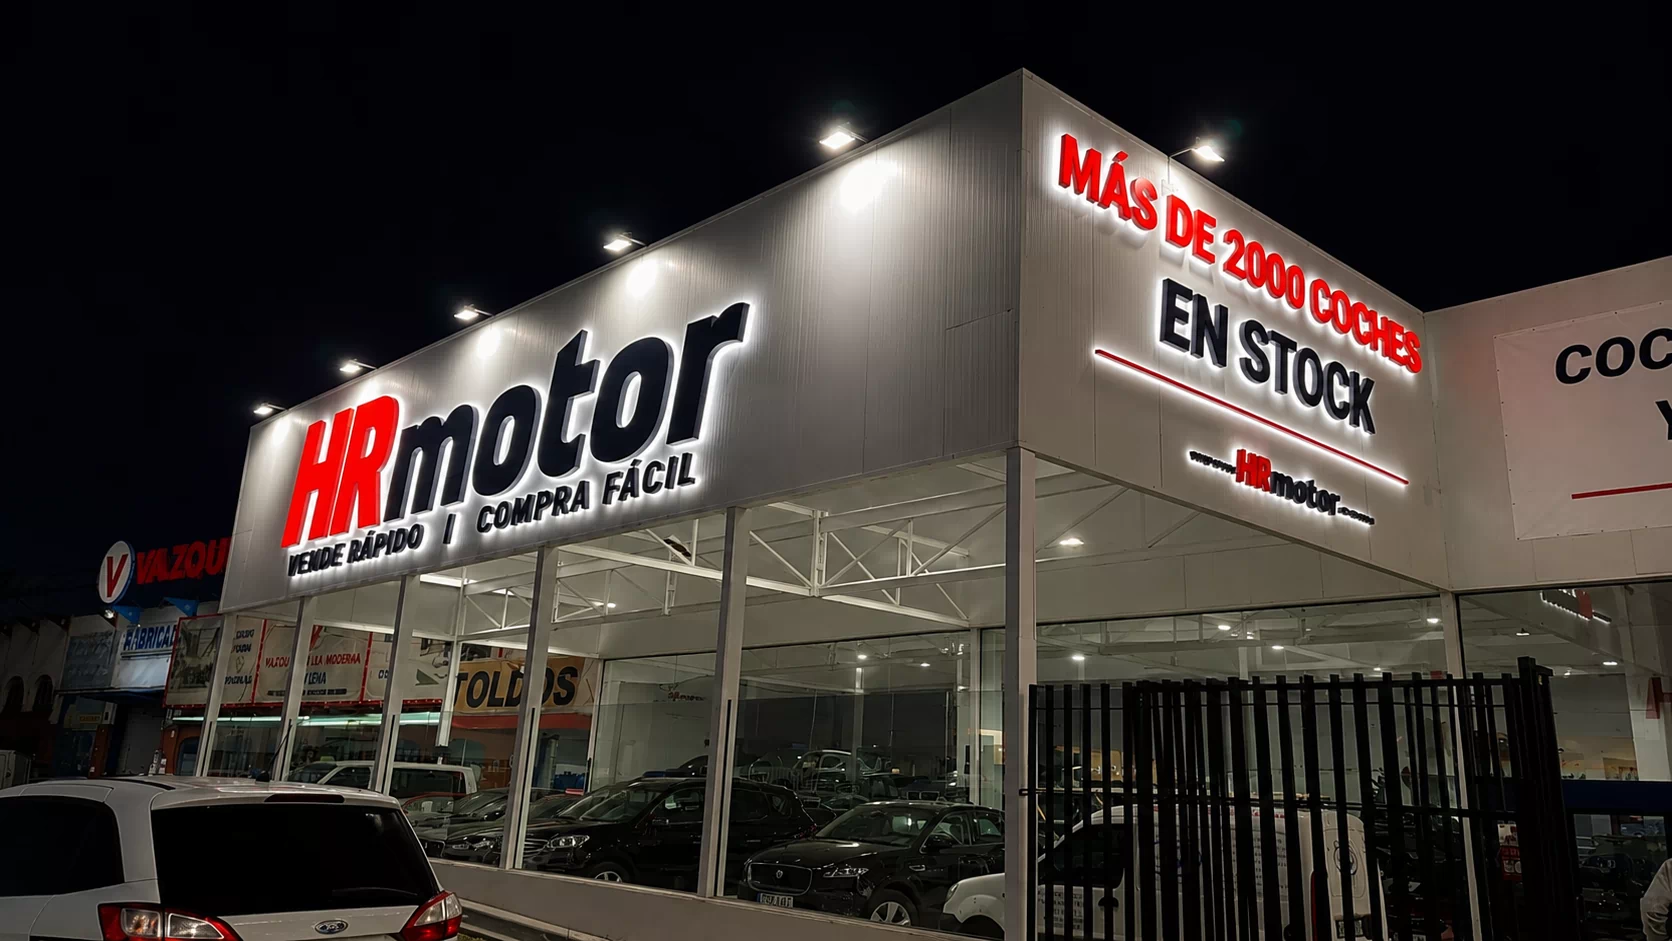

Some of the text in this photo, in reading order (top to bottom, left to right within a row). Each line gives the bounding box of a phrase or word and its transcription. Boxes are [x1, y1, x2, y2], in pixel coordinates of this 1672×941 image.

[1058, 133, 1422, 374] MÁS DE 2000 COCHES
[1160, 278, 1375, 435] EN STOCK
[1555, 327, 1672, 385] COC
[288, 543, 347, 577] VENDE
[347, 523, 425, 564] RÁPIDO
[476, 480, 590, 533] COMPRA
[602, 452, 696, 505] FÁCIL
